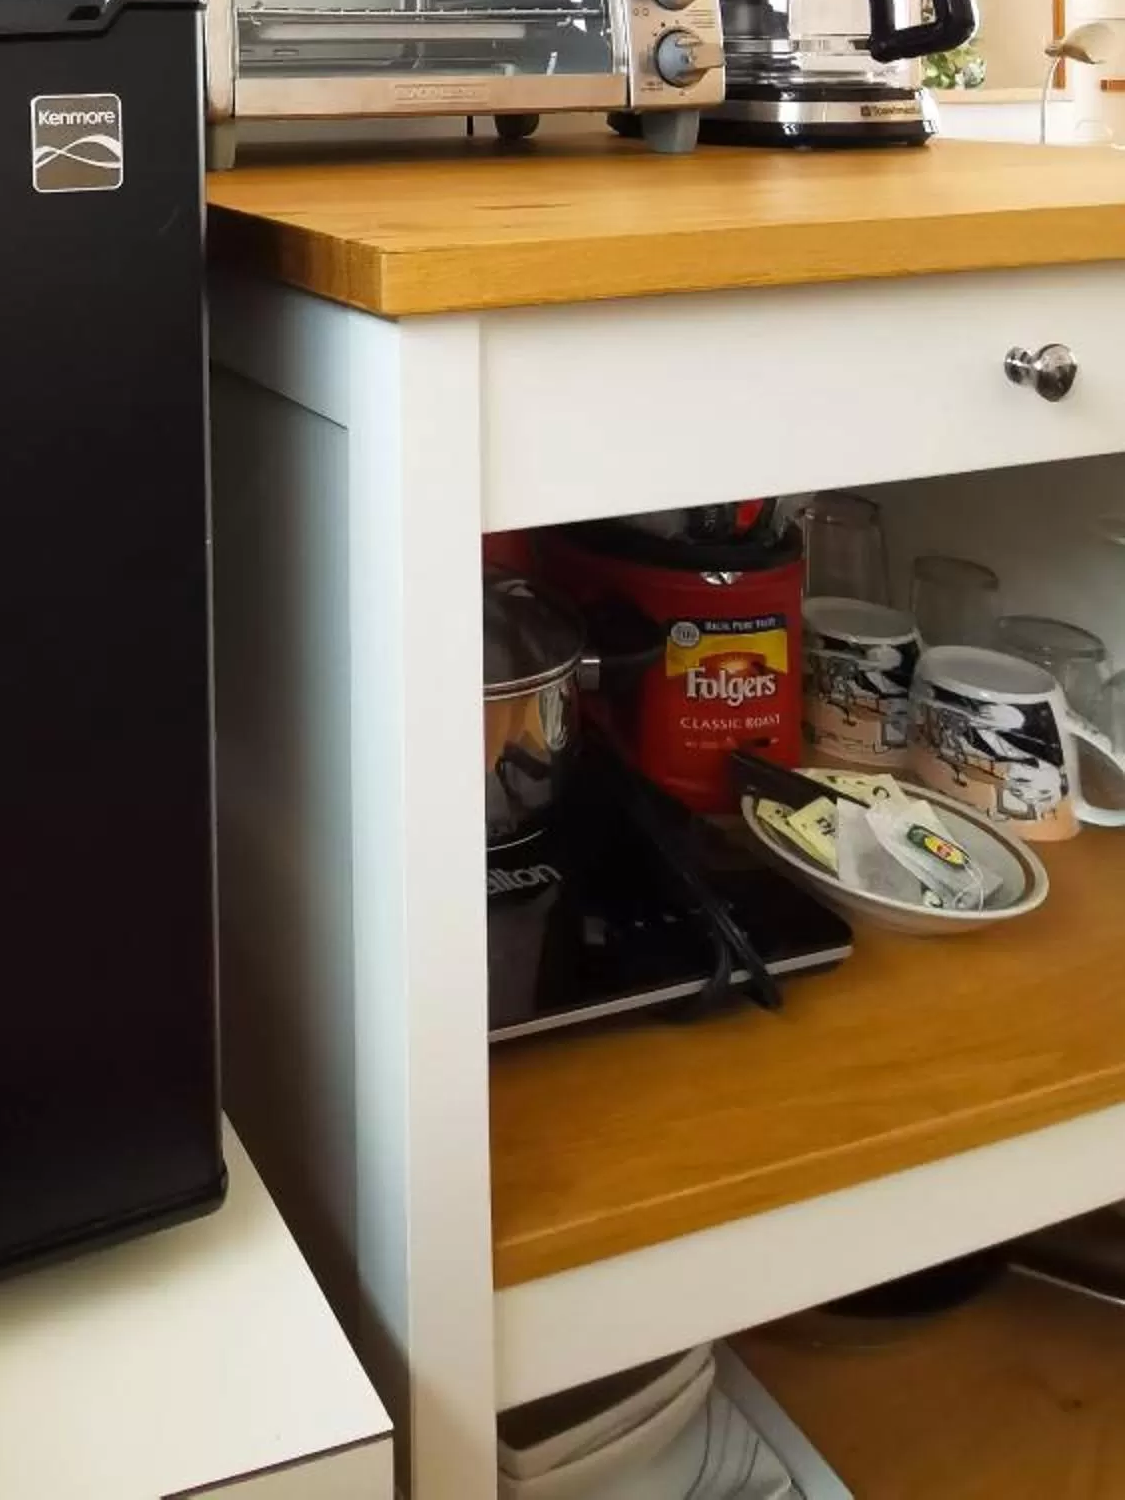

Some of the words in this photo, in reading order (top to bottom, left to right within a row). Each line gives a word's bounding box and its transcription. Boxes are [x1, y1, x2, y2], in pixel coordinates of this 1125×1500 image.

[38, 110, 115, 126] Kenmore
[686, 666, 777, 707] Folgers
[679, 716, 742, 730] CLASSIC
[744, 713, 780, 729] ROAST
